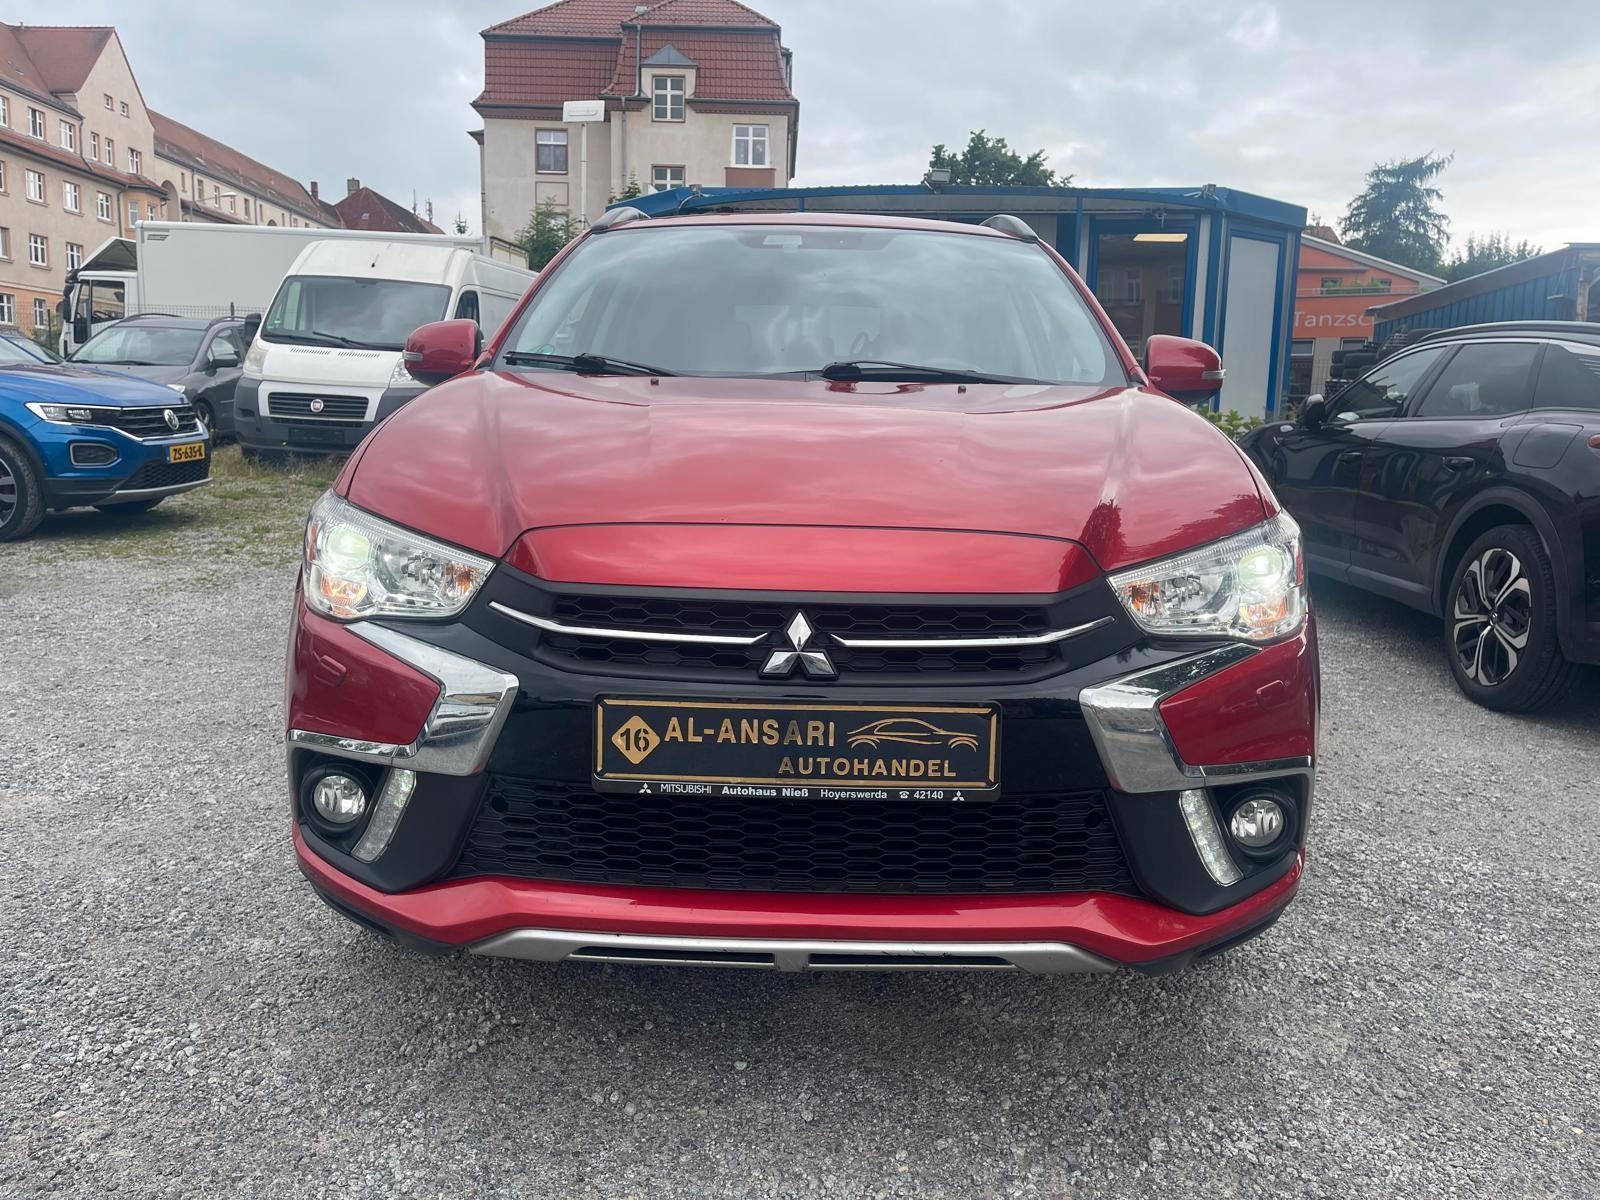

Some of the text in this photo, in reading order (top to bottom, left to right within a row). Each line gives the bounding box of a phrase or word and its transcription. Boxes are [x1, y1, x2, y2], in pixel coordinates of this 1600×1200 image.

[620, 727, 649, 752] 16
[664, 716, 835, 747] AL-ANSARI
[777, 756, 957, 777] AUTOHANDEL
[660, 783, 944, 801] MITSUBISHI Autohaus Nieß Hoyerswerda 42140
